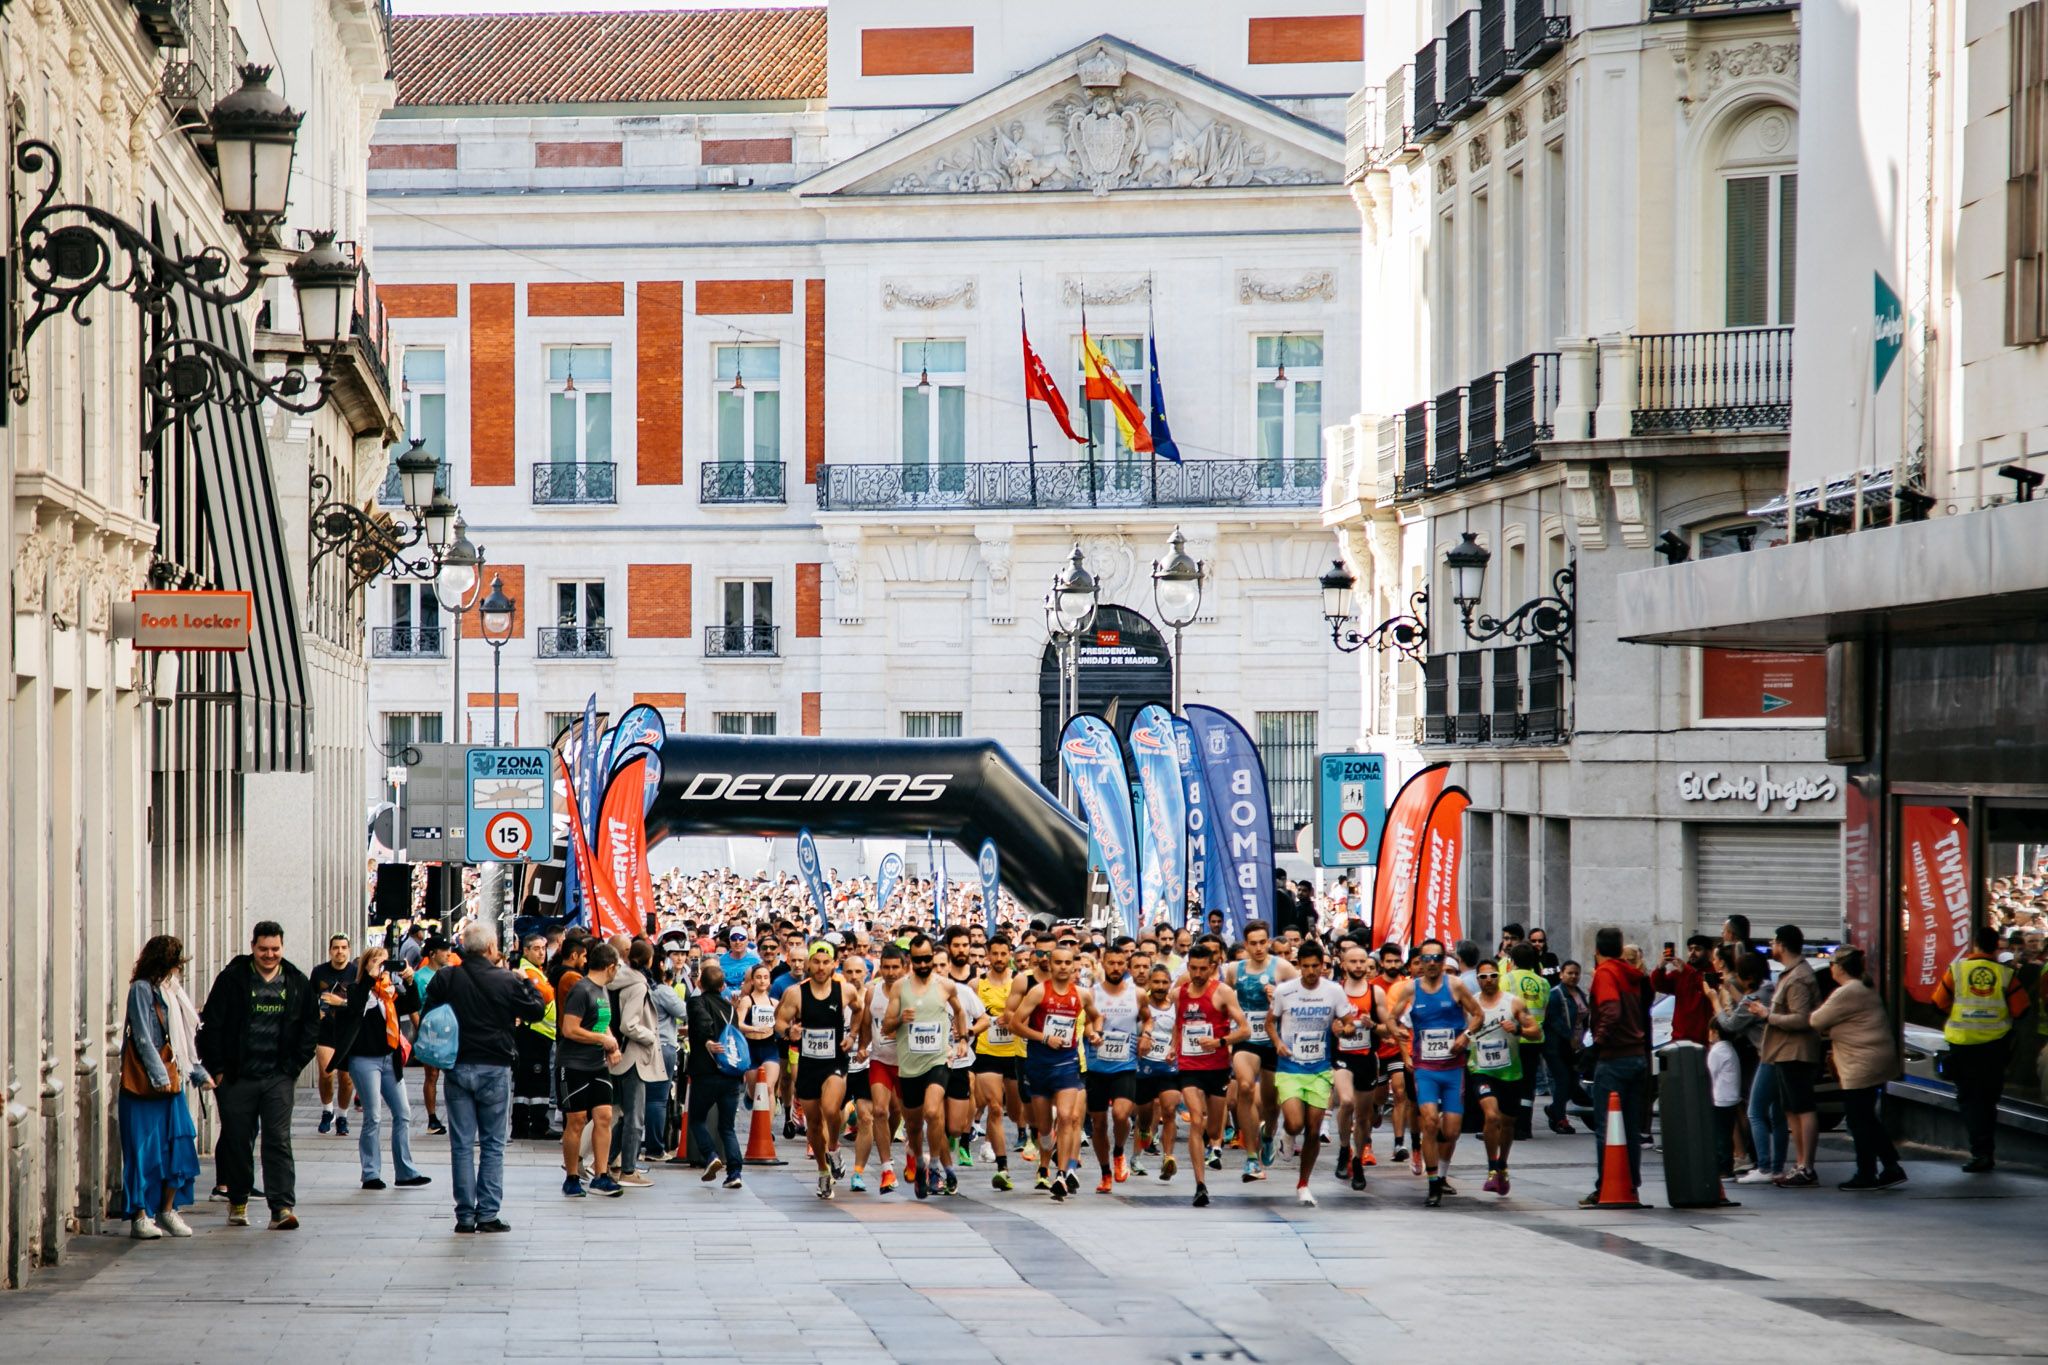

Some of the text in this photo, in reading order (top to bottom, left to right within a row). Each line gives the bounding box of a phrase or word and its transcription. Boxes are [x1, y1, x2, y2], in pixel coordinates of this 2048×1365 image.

[141, 613, 241, 628] Foot Locker
[1080, 647, 1136, 655] PRESIDENCIA
[1078, 656, 1158, 664] UNIDAD DE MADRID
[497, 757, 544, 768] ZONA
[1344, 762, 1381, 774] ZONA
[1344, 773, 1381, 781] PEATONAL
[681, 773, 953, 801] DECIMAS
[1679, 765, 1837, 812] El Corte Inglés
[499, 828, 519, 843] 15
[1442, 839, 1454, 908] Nutrition
[1291, 1006, 1331, 1016] MADRID
[808, 1040, 829, 1050] 2286
[914, 1035, 936, 1045] 1905
[1105, 1044, 1123, 1053] 1237
[1427, 1041, 1449, 1051] 2234
[1485, 1051, 1501, 1060] 616
